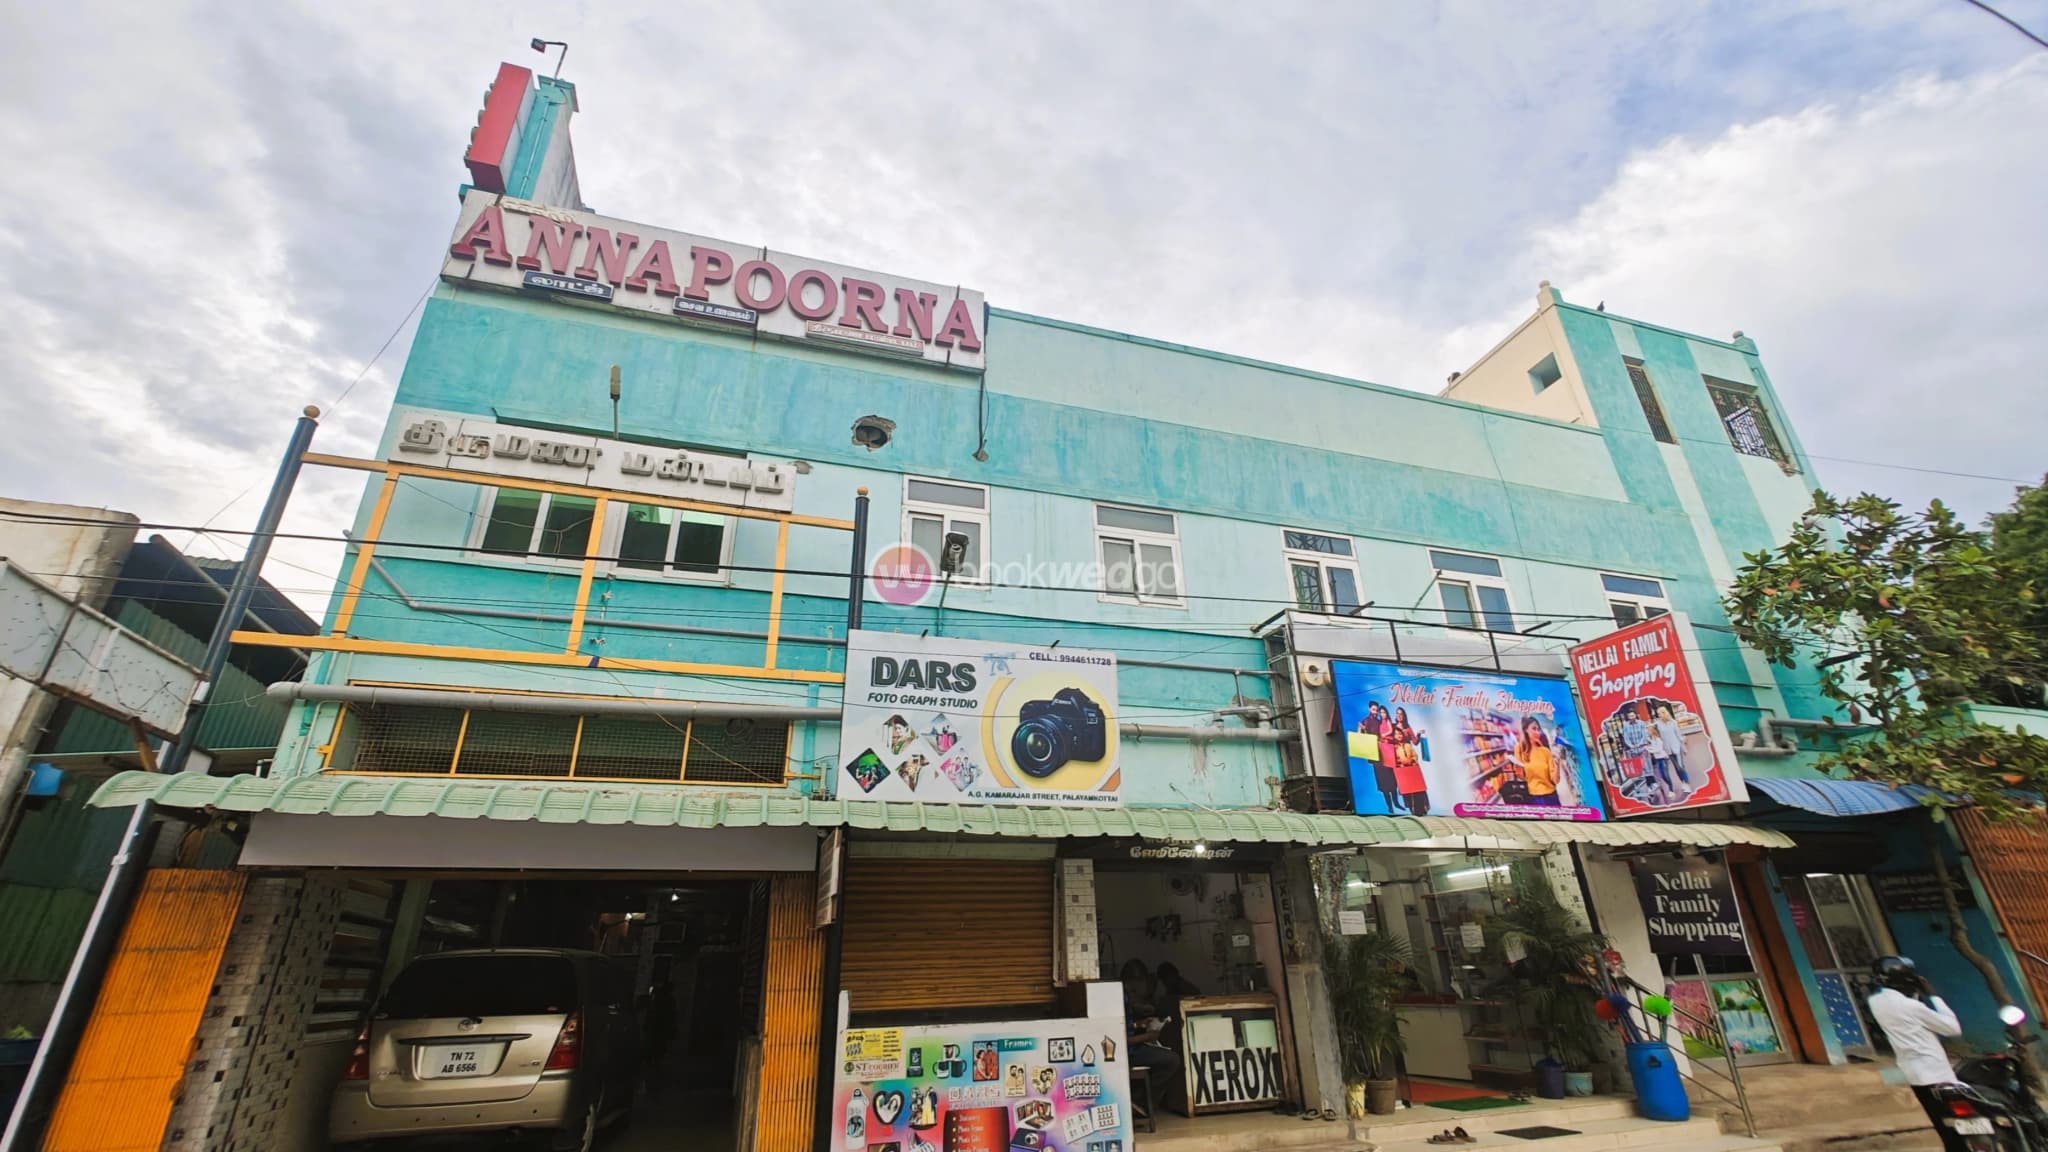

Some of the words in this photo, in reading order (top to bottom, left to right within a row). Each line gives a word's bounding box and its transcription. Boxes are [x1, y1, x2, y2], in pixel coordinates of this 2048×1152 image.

[450, 206, 982, 352] ANNAPOORNA
[1029, 652, 1052, 661] CELL
[1578, 645, 1619, 675] NELLAI
[1622, 627, 1669, 662] FAMILY
[871, 656, 977, 693] DARS
[1588, 661, 1676, 699] Shopping
[867, 692, 898, 704] FOTO
[900, 695, 938, 707] GRAPH
[938, 697, 978, 709] STUDIO
[1391, 682, 1437, 705] Nellai
[1442, 684, 1489, 712] Family
[1496, 689, 1556, 721] Shopping
[1652, 870, 1713, 891] Nellai
[1654, 893, 1720, 917] Family
[1648, 916, 1742, 941] Shopping
[441, 1064, 455, 1073] AB
[451, 1051, 463, 1061] TN
[464, 1051, 475, 1061] 72
[1191, 1047, 1278, 1105] XEROX
